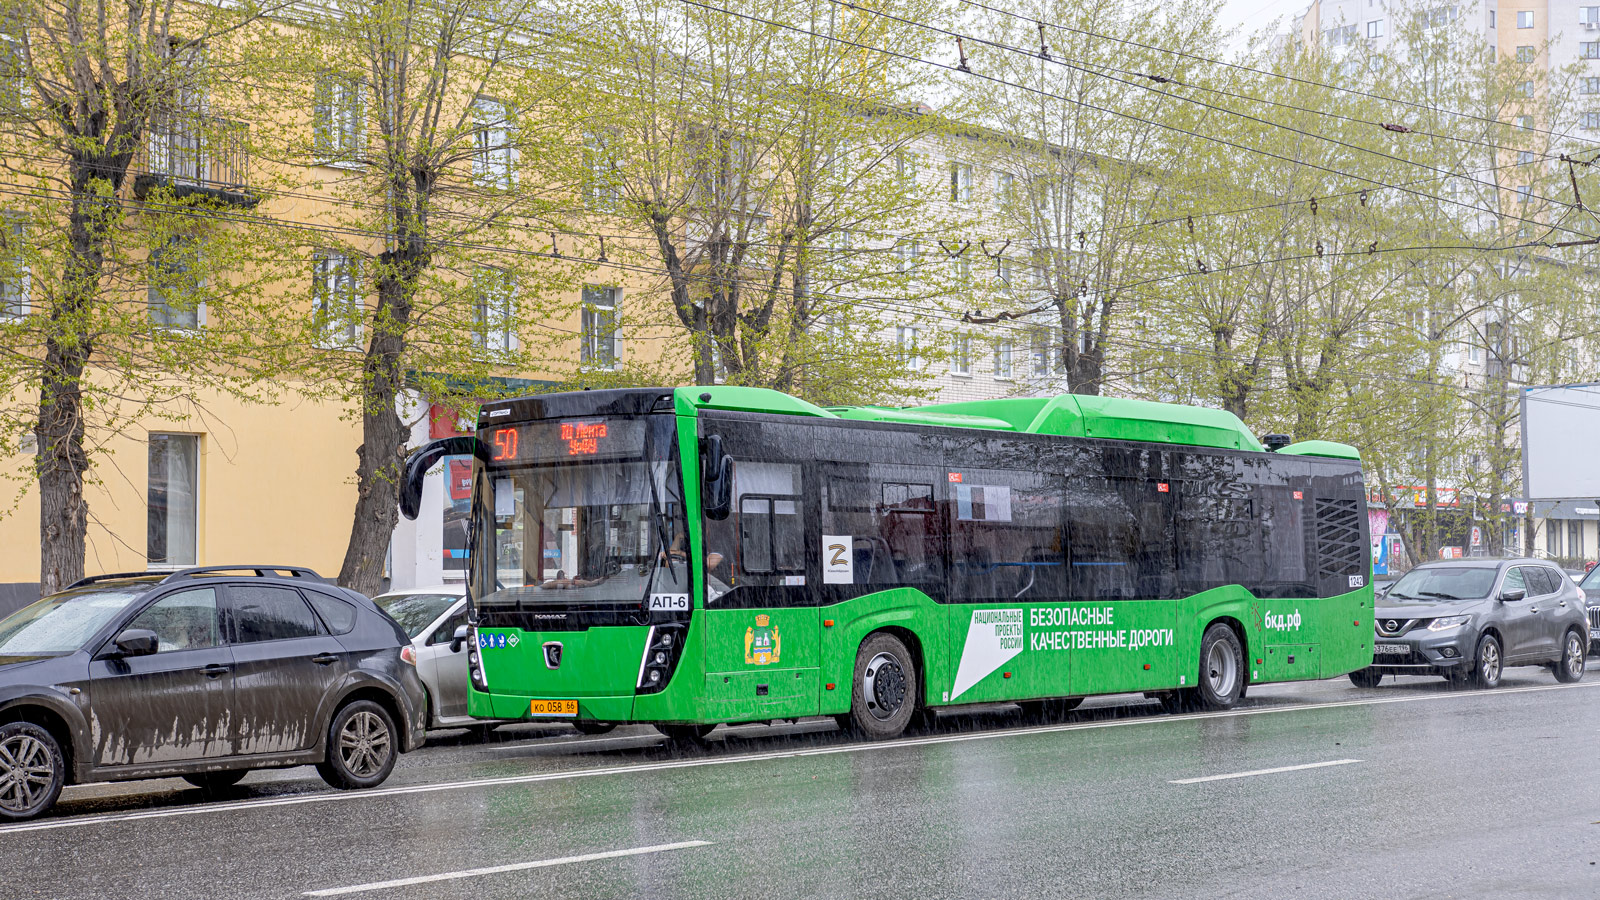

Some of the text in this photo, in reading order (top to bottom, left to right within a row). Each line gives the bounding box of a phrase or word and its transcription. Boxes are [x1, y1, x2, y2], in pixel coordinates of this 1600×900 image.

[561, 421, 608, 440] ТЦ Лента
[493, 428, 518, 460] 50
[568, 438, 598, 455] УрФУ
[828, 543, 848, 566] Z
[1350, 576, 1363, 586] 1242
[651, 595, 686, 609] АП-6
[974, 610, 1022, 625] НАЦИОНАЛЬНЫЕ
[1030, 607, 1114, 627] БЕЗОПАСНЫЕ
[1264, 608, 1302, 632] бкд.рф
[994, 624, 1022, 637] ПРОЕКТЫ
[1000, 637, 1022, 650] РОССИИ
[1030, 628, 1174, 651] КАЧЕСТВЕННЫЕ ДОРОГИ
[534, 701, 575, 713] КО 058 66
